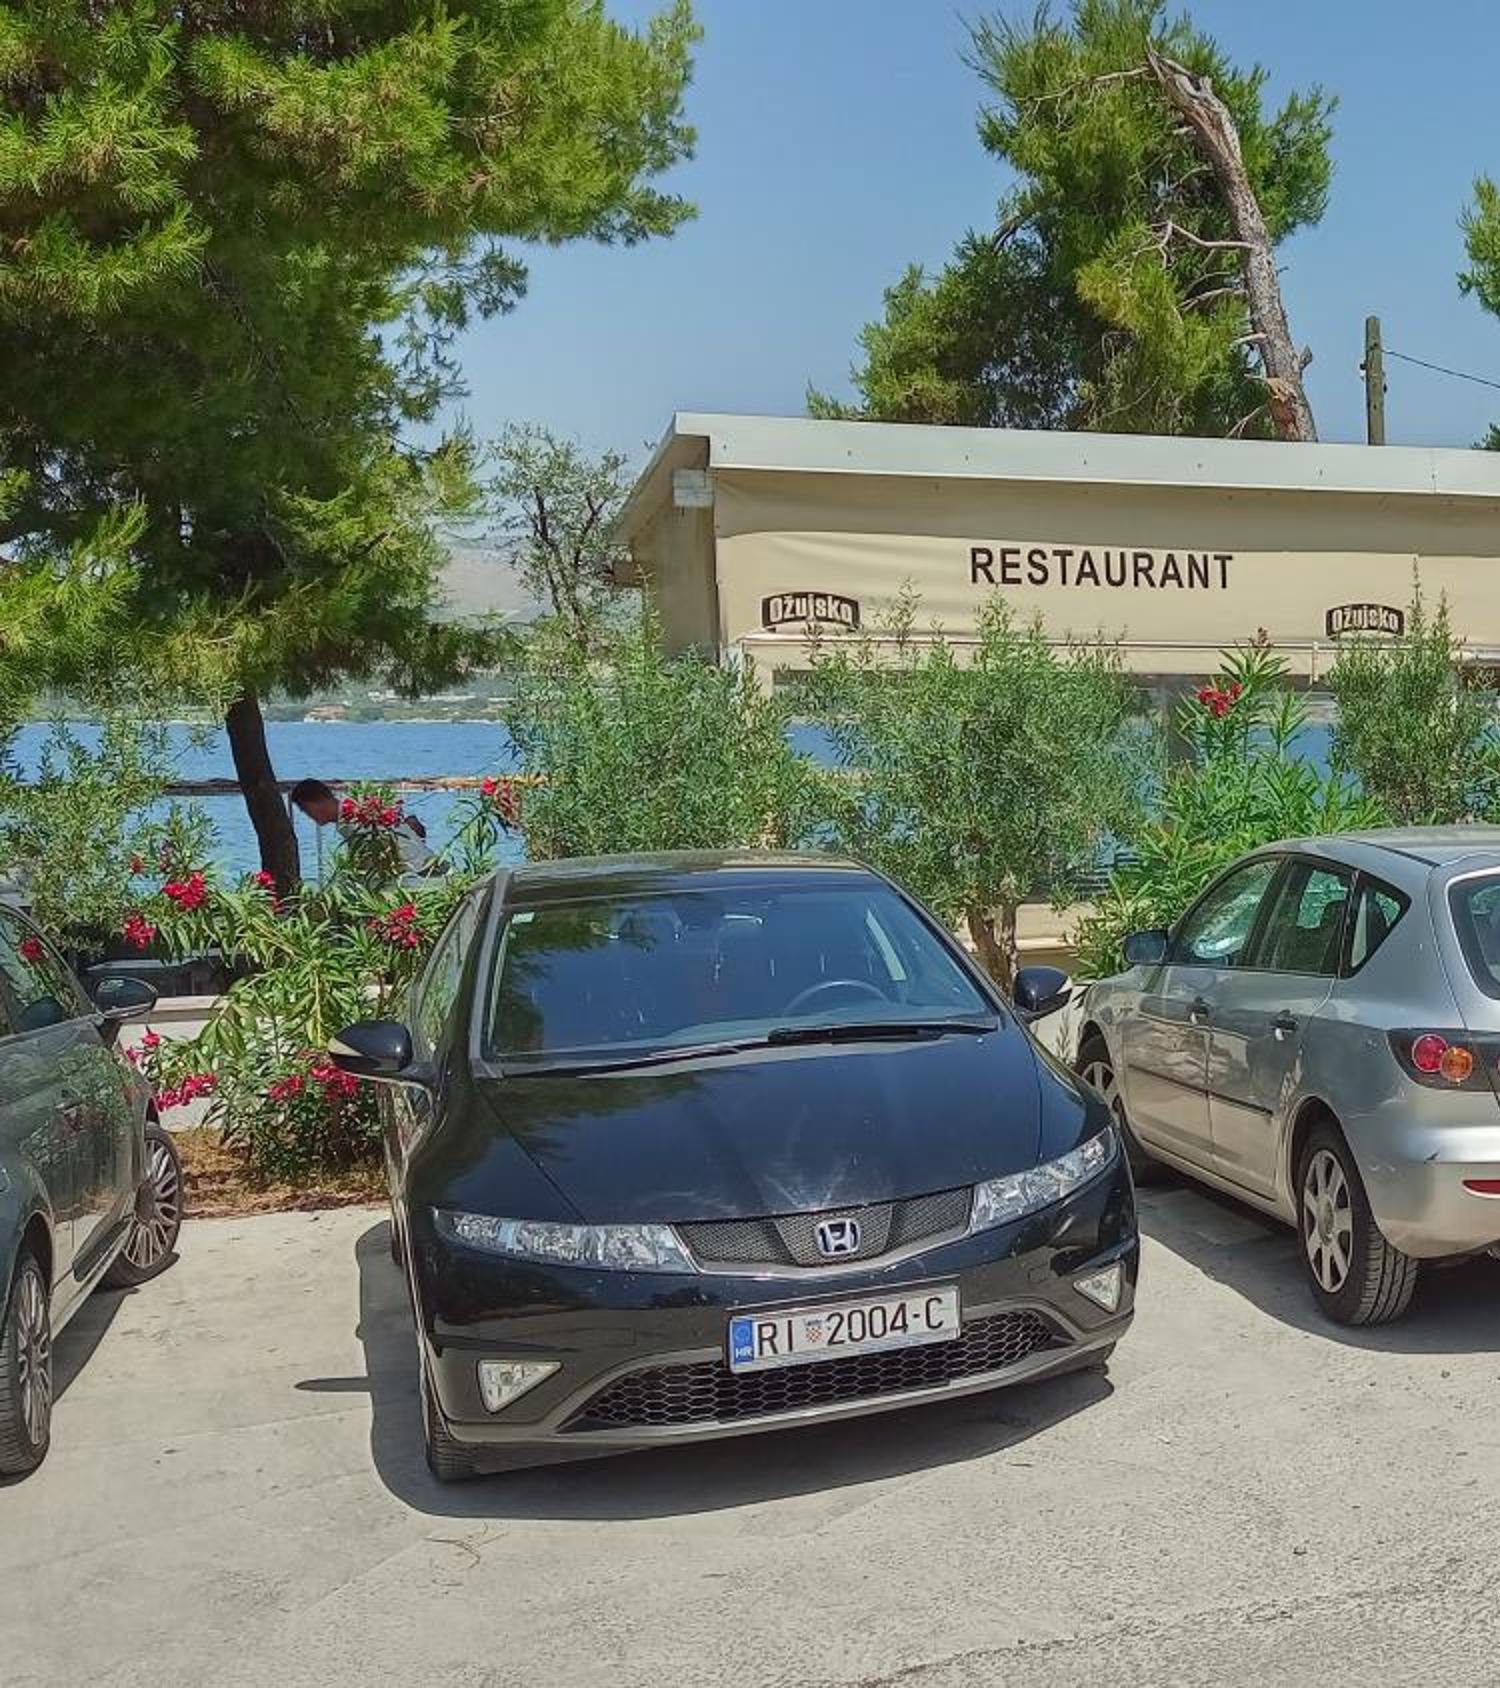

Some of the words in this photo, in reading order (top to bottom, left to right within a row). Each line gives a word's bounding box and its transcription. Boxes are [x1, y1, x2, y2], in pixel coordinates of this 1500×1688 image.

[970, 547, 1233, 589] RESTAURANT
[768, 593, 854, 625] Ožujsko
[1331, 605, 1399, 632] Ožujsko
[757, 1319, 794, 1357] RI
[827, 1296, 945, 1347] 2004-C
